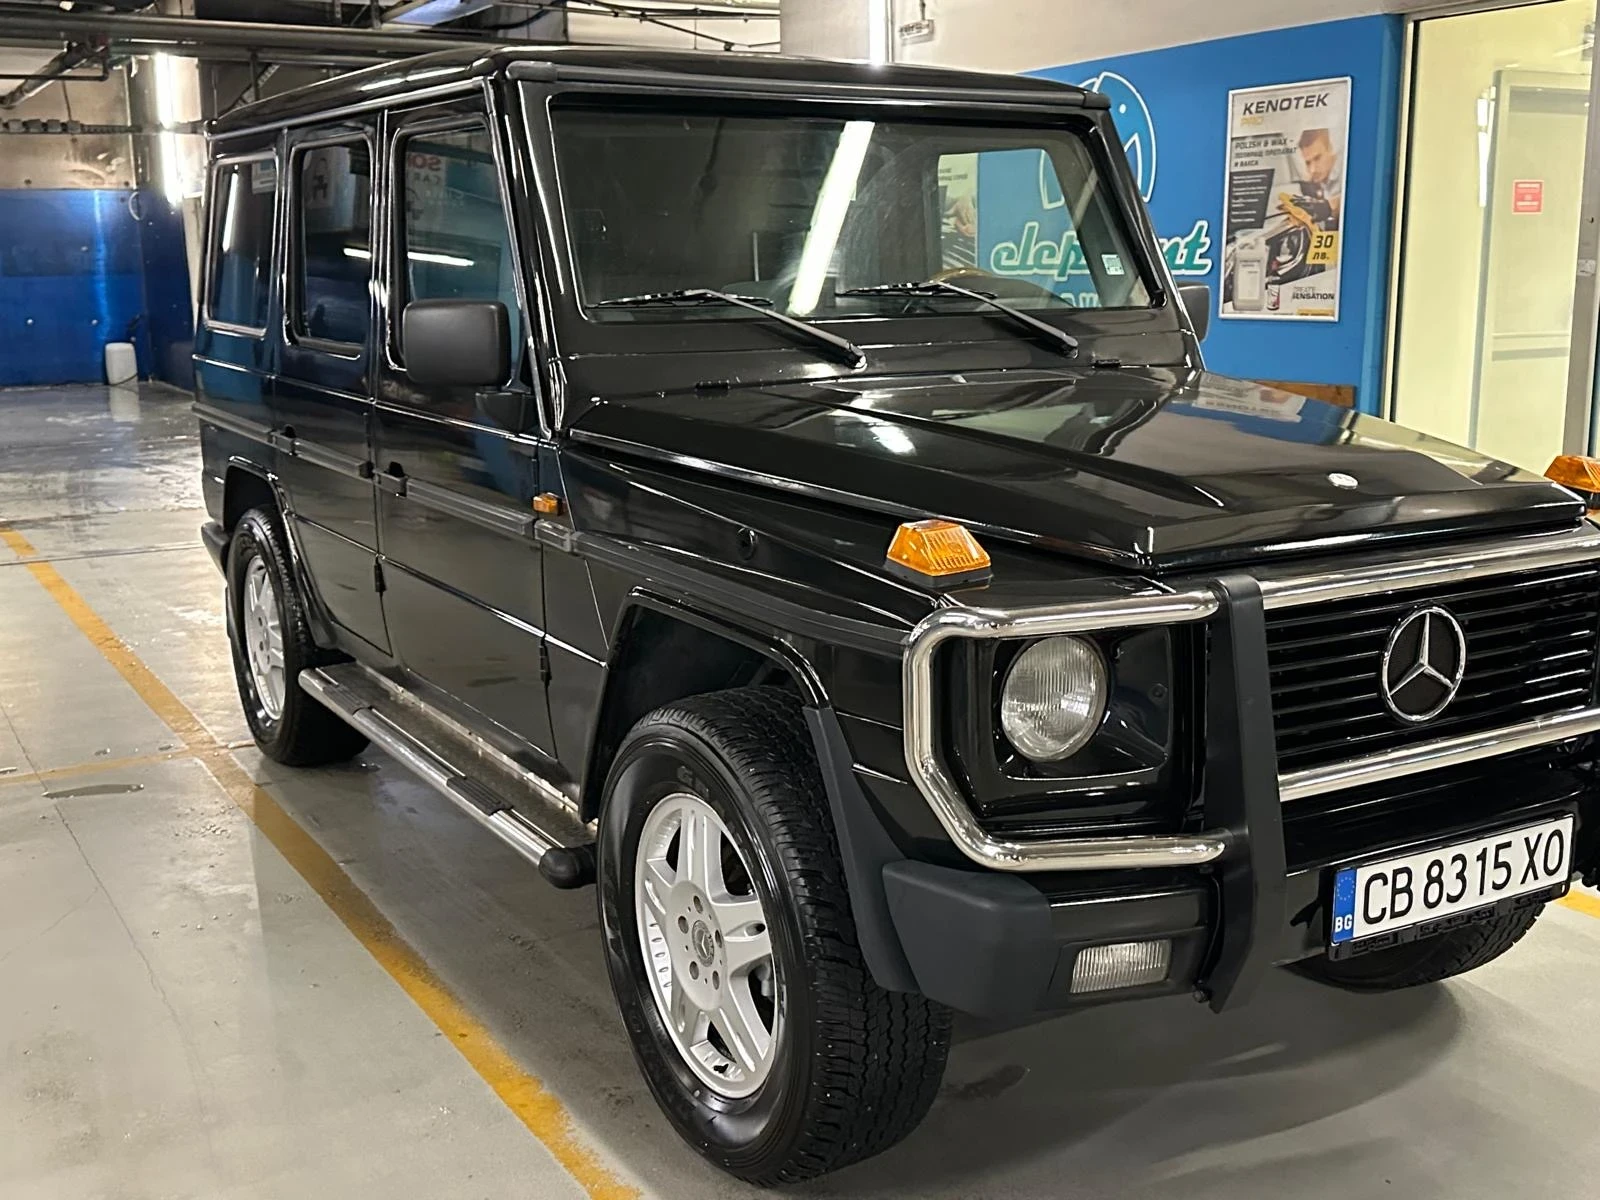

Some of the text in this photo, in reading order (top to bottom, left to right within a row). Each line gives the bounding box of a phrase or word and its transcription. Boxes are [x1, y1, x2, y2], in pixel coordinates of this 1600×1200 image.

[1243, 92, 1329, 116] KENOTEK
[1235, 141, 1262, 149] POLISH
[1271, 138, 1288, 146] WAX
[1313, 234, 1334, 249] 30
[1362, 866, 1414, 926] CB
[1423, 840, 1513, 910] 8315
[1519, 828, 1565, 886] XO
[1334, 913, 1354, 933] BG
